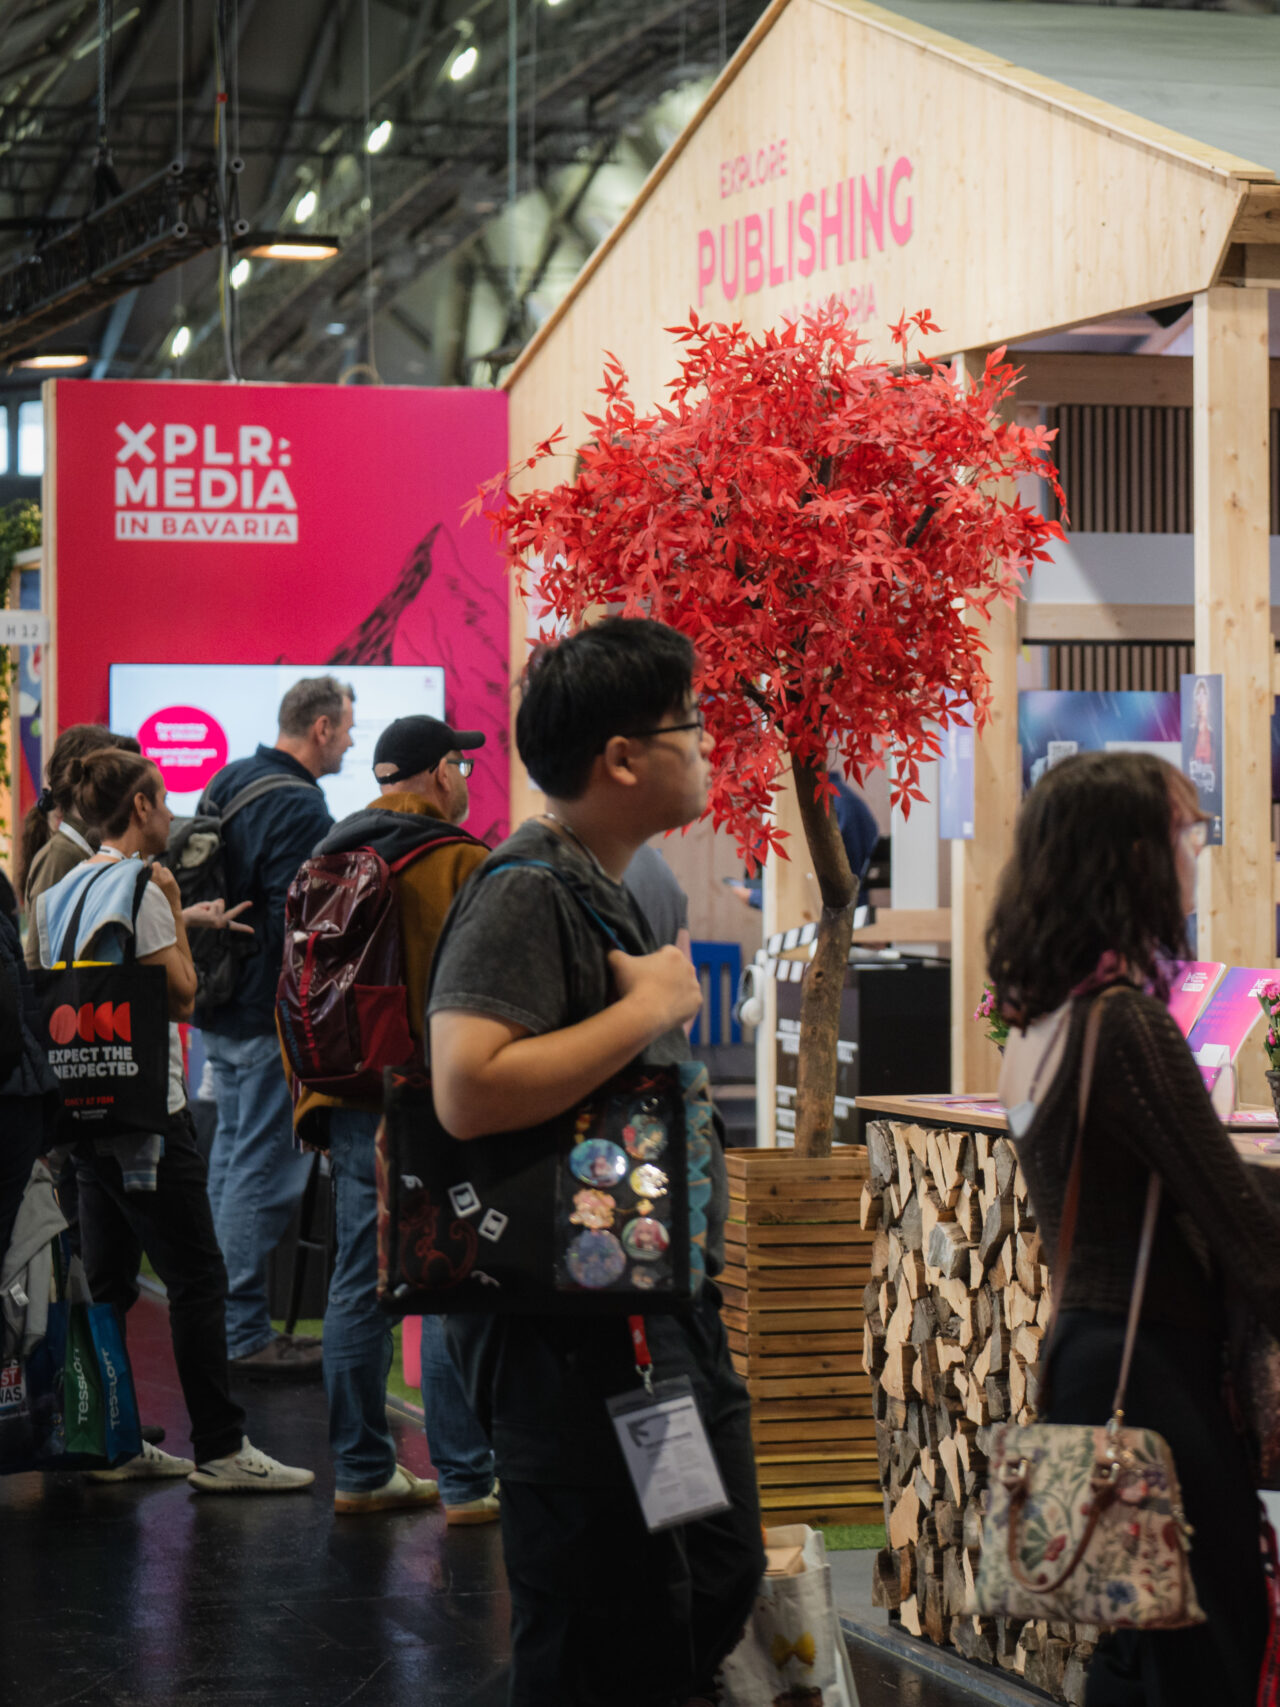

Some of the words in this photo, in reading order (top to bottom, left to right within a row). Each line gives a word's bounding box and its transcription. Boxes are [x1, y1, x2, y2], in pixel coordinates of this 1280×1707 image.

[721, 139, 788, 199] EXPLORE
[698, 156, 914, 308] PUBLISHING
[115, 421, 292, 467] XPLR:
[114, 466, 298, 510] MEDIA
[120, 516, 149, 535] IN
[161, 516, 292, 537] BAVARIA
[48, 1046, 100, 1065] EXPECT
[102, 1046, 133, 1061] THE
[53, 1061, 139, 1079] NEXPECTED
